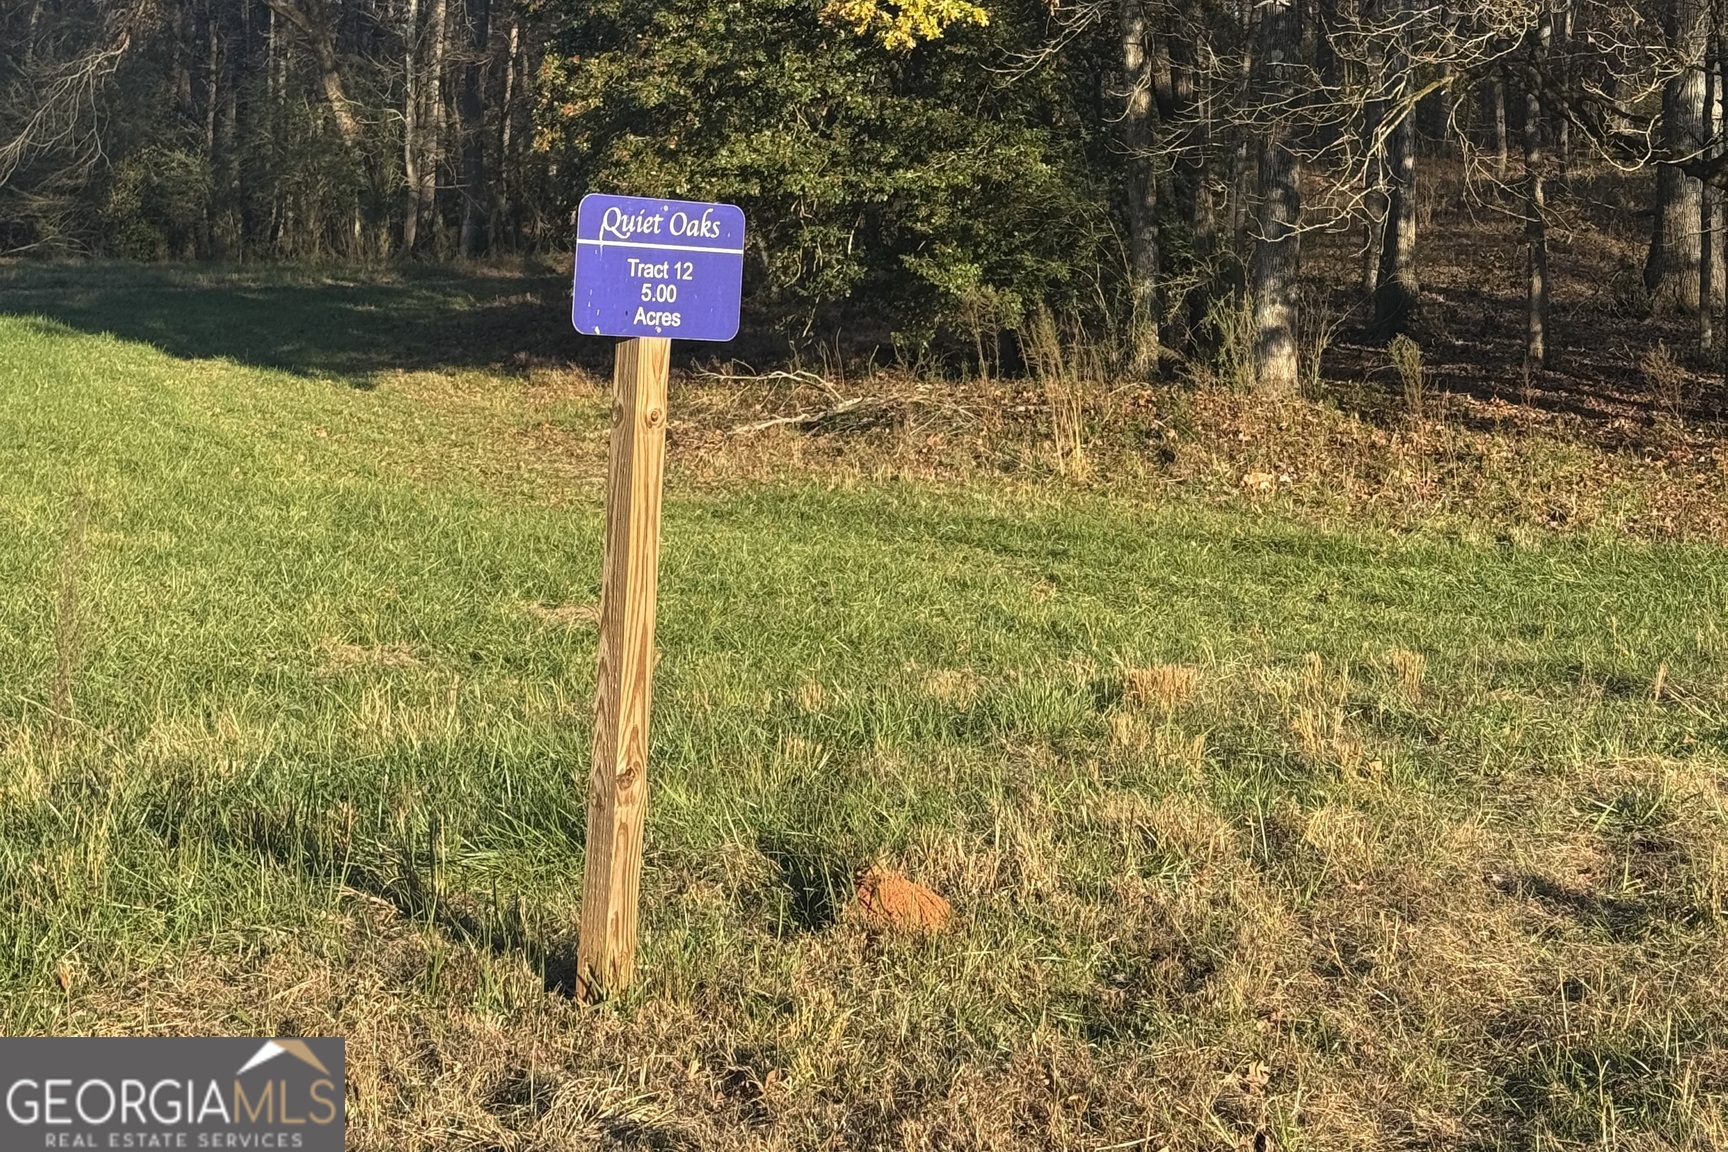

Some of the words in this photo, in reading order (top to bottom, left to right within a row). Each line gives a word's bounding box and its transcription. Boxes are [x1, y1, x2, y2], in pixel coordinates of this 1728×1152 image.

[602, 206, 664, 239] Quiet
[669, 208, 721, 239] Oaks
[627, 258, 669, 279] Tract
[674, 261, 693, 280] 12
[641, 283, 677, 303] 5.00
[633, 306, 681, 327] Acres
